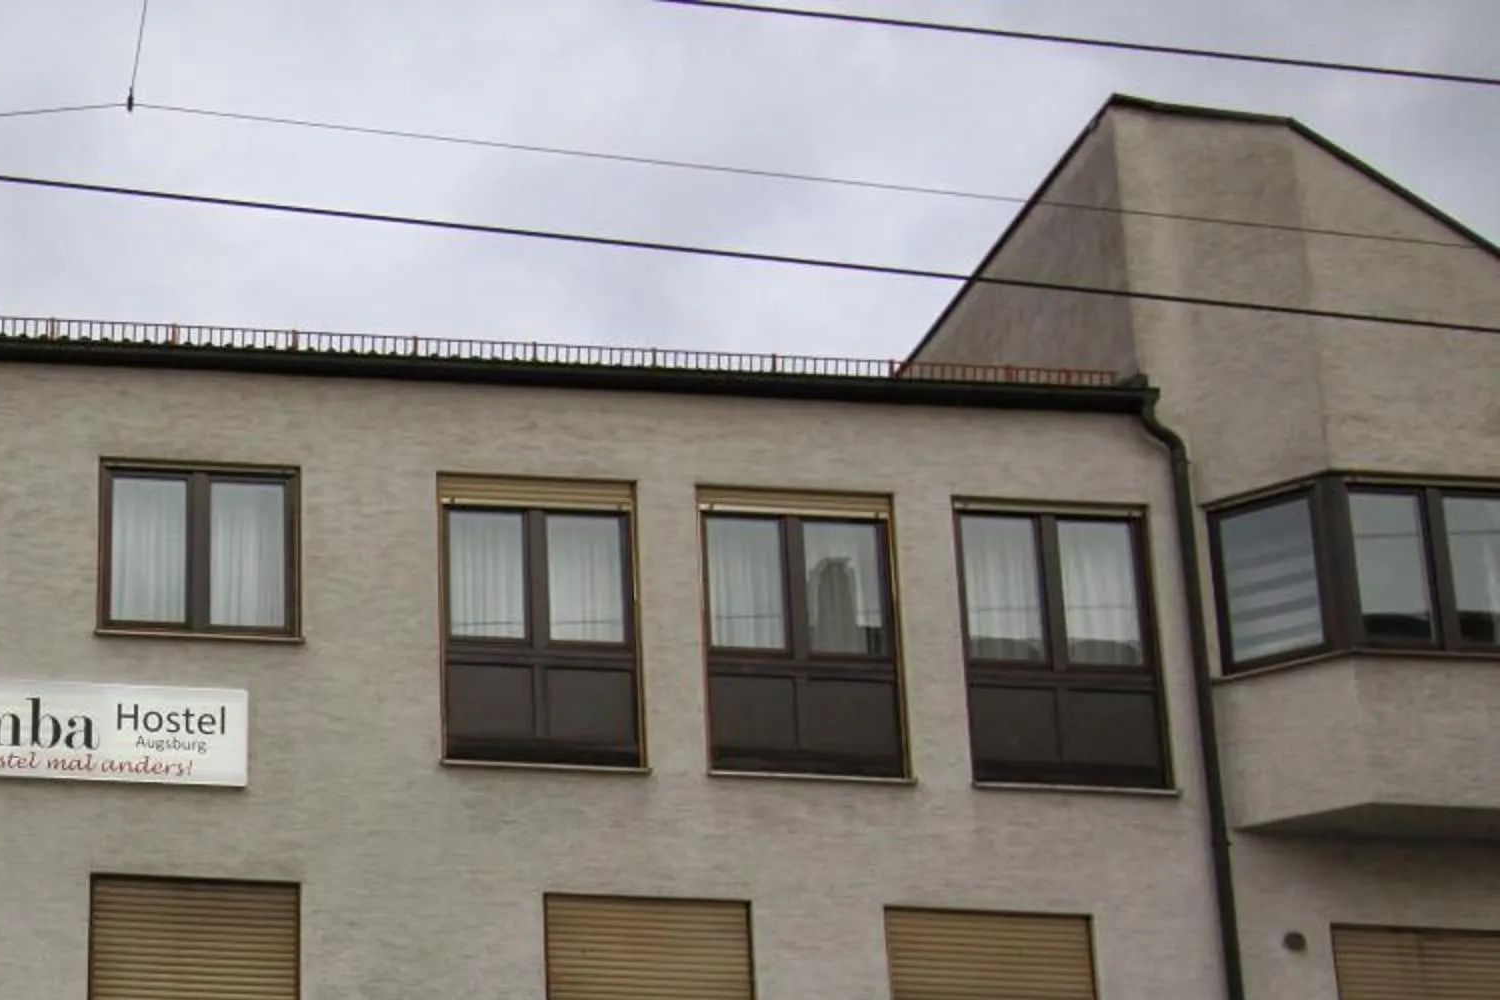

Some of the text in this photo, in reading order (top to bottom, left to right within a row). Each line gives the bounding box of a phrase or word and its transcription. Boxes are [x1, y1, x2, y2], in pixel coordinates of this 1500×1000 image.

[116, 703, 226, 736] Hostel
[135, 734, 208, 753] Augsburg
[46, 751, 98, 772] mal
[101, 755, 194, 777] anders!
